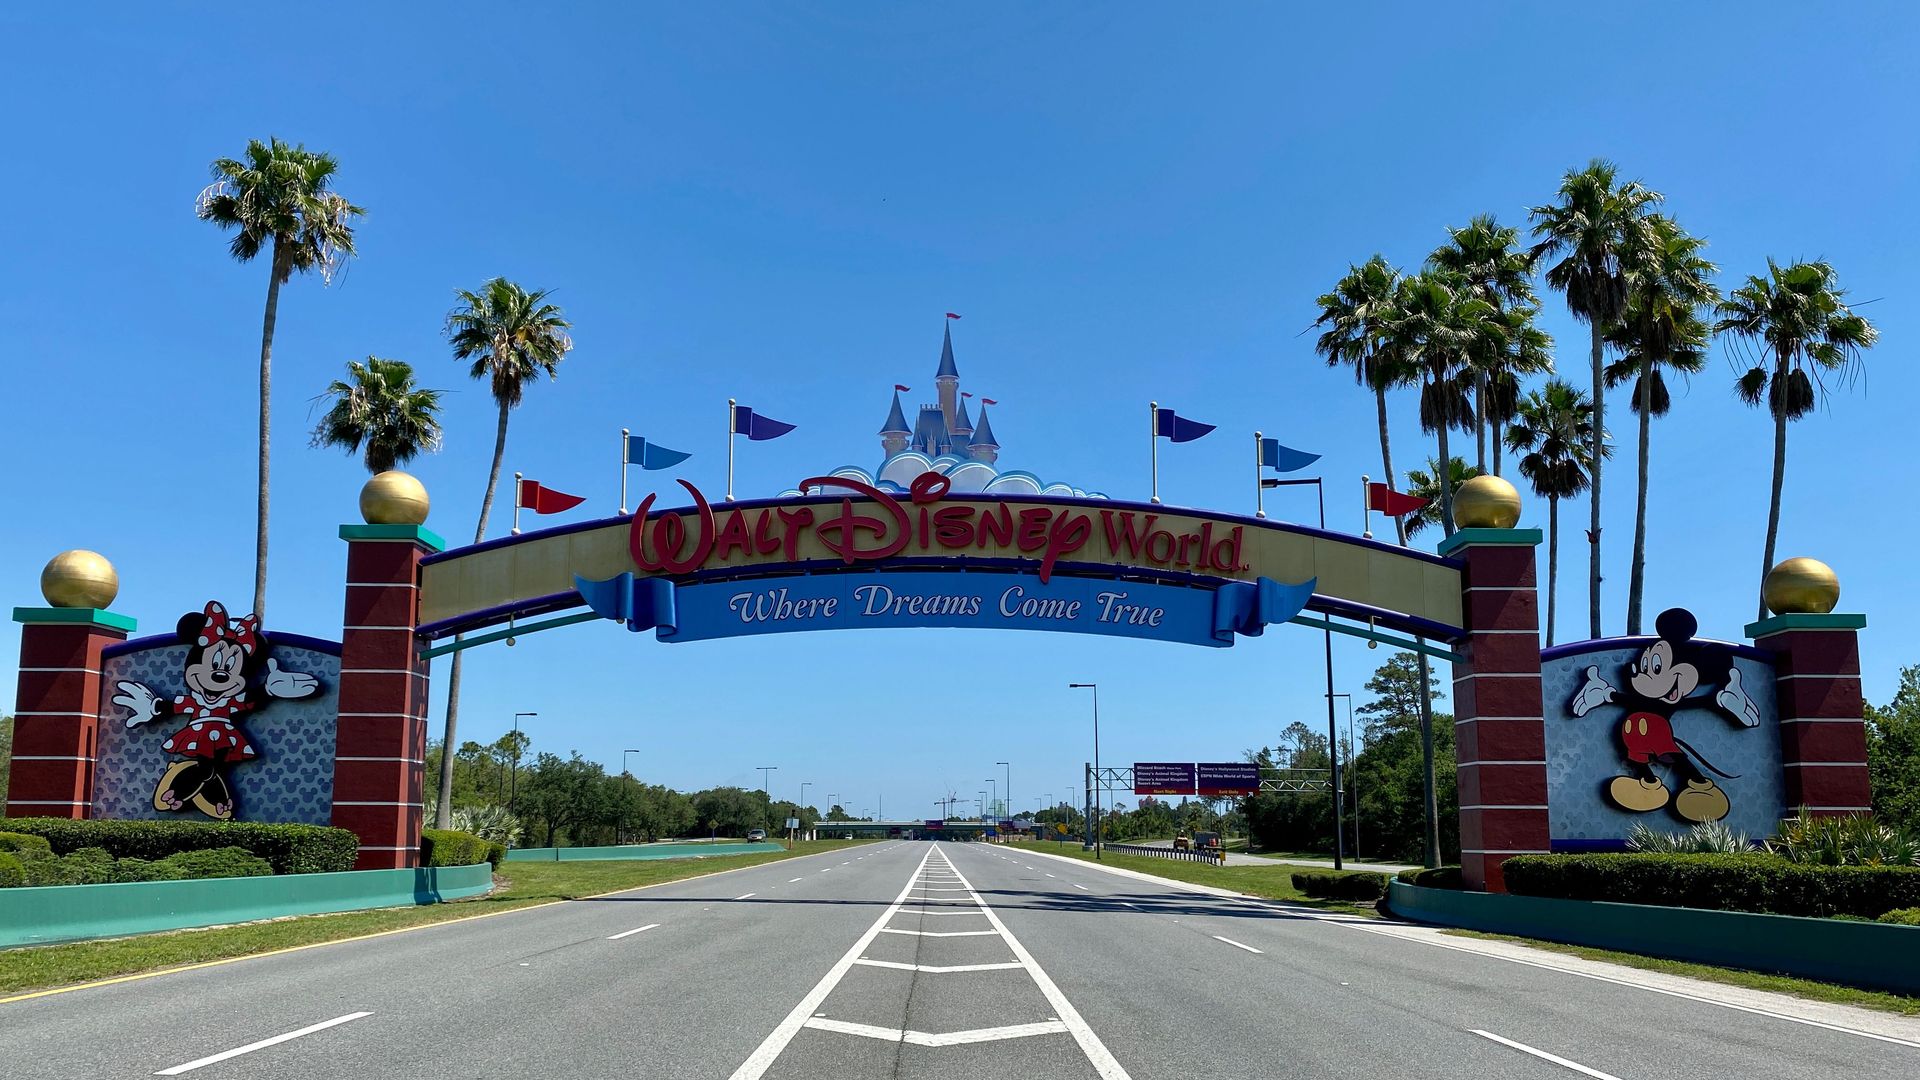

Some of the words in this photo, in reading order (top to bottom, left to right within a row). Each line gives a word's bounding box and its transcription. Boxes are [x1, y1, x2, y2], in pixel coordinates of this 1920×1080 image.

[729, 588, 838, 623] Where
[854, 584, 981, 615] Dreams
[998, 585, 1082, 620] Come
[1096, 592, 1165, 627] True
